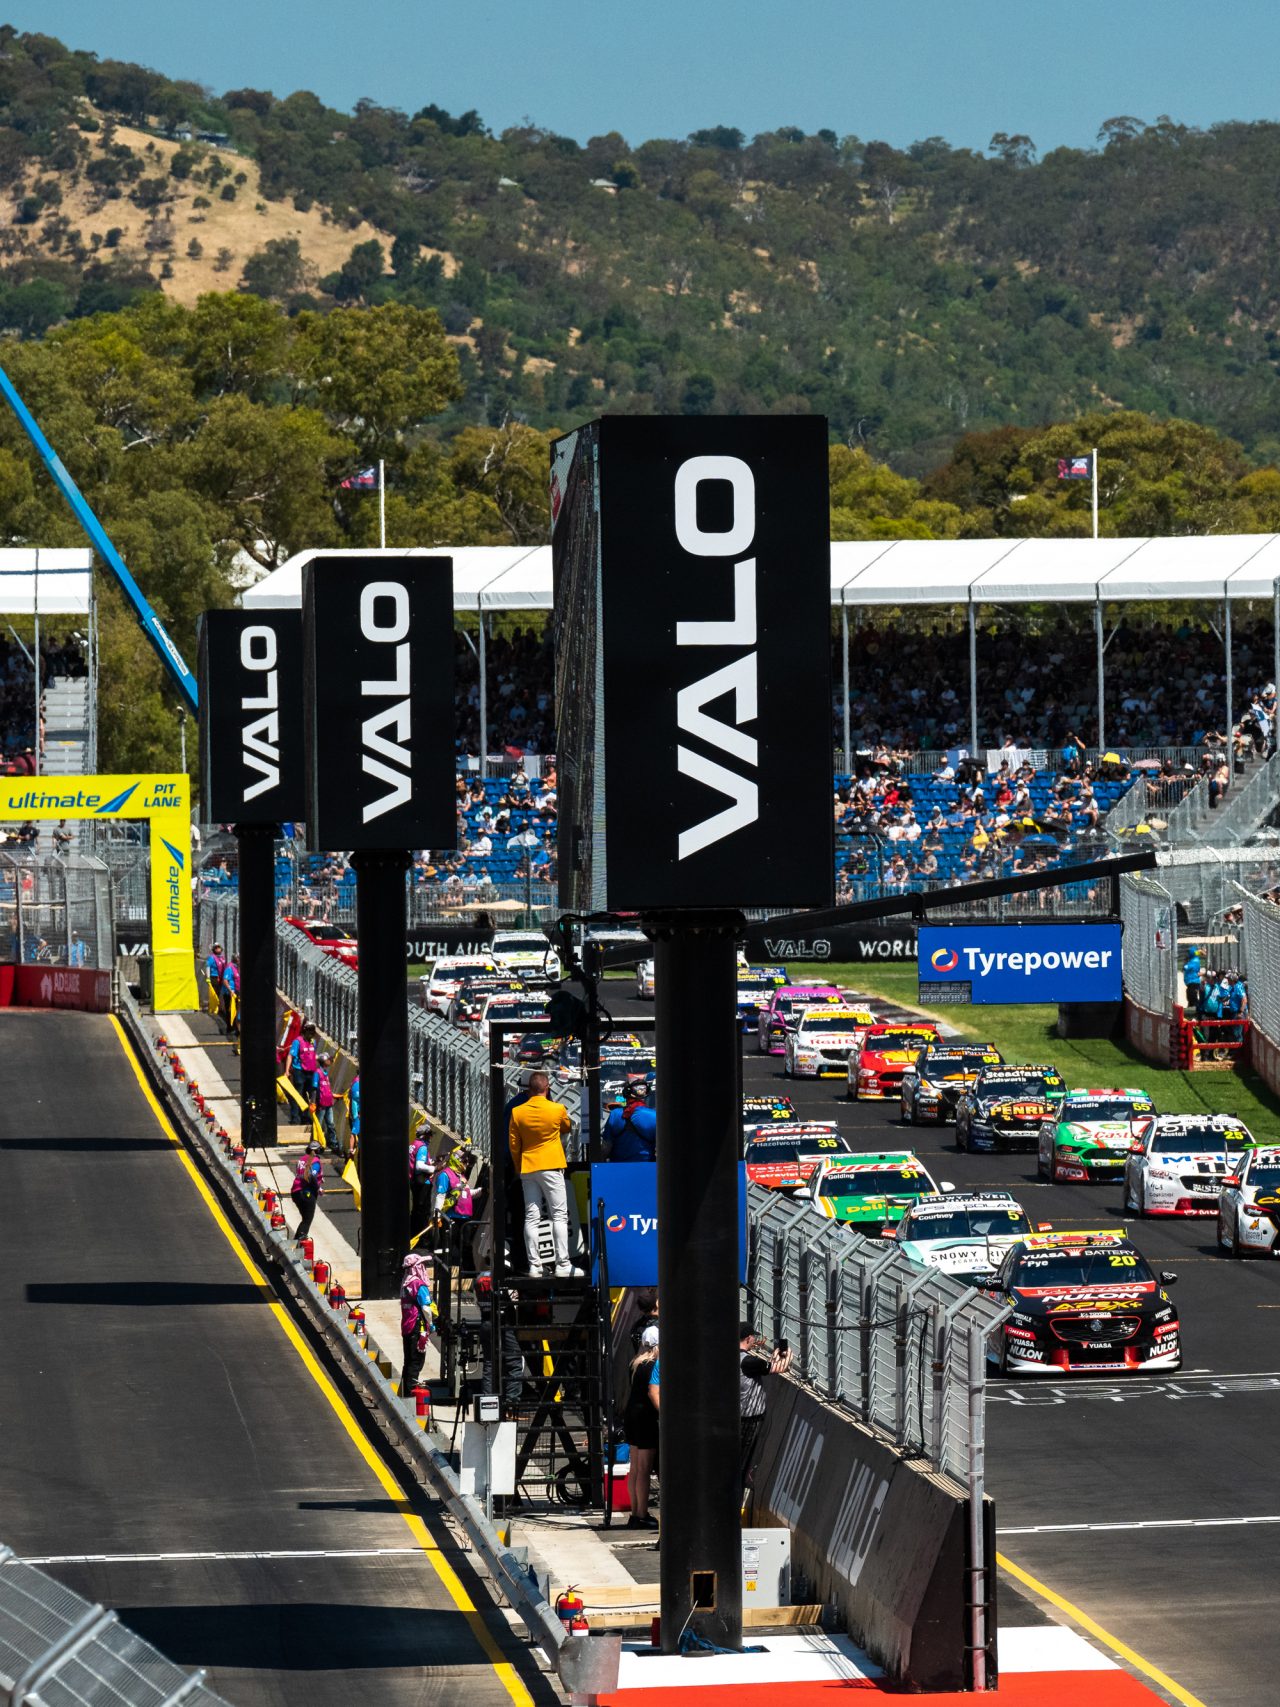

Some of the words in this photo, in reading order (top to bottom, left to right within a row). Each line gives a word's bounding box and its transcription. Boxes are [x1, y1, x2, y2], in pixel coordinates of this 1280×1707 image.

[674, 455, 759, 861] VALO
[360, 581, 412, 824] VALO
[240, 625, 280, 802] VALO
[154, 784, 176, 793] PIT
[8, 790, 100, 808] ultimate
[144, 797, 181, 807] LANE
[166, 866, 180, 934] ultimate
[406, 942, 447, 956] OUTH
[764, 938, 831, 958] VALO
[859, 940, 919, 956] WORL
[963, 948, 1112, 976] Tyrepower
[986, 1070, 1043, 1079] Steadfast
[983, 1077, 1027, 1085] Holdsworth
[1043, 1077, 1060, 1086] 10
[990, 1104, 1056, 1116] PENRI
[1132, 1103, 1150, 1111] 55
[772, 1109, 790, 1118] 26
[1224, 1131, 1244, 1140] 25
[818, 1139, 838, 1148] 35
[1162, 1155, 1239, 1164] Mob
[826, 1163, 917, 1174] HIFLEX
[900, 1169, 919, 1179] 31
[1056, 1166, 1084, 1178] RYCO
[918, 1213, 954, 1221] Courtney
[1007, 1210, 1020, 1221] 5
[931, 1251, 977, 1263] SNOWY
[1022, 1251, 1066, 1260] YUASA
[1085, 1249, 1135, 1257] BATTERY
[1027, 1260, 1049, 1268] Pye
[1109, 1256, 1136, 1267] 20
[1042, 1293, 1140, 1303] NULON
[1012, 1329, 1031, 1338] HINO
[1013, 1338, 1035, 1348] YUASA
[1009, 1345, 1044, 1360] NULON
[826, 1457, 890, 1588] VALO
